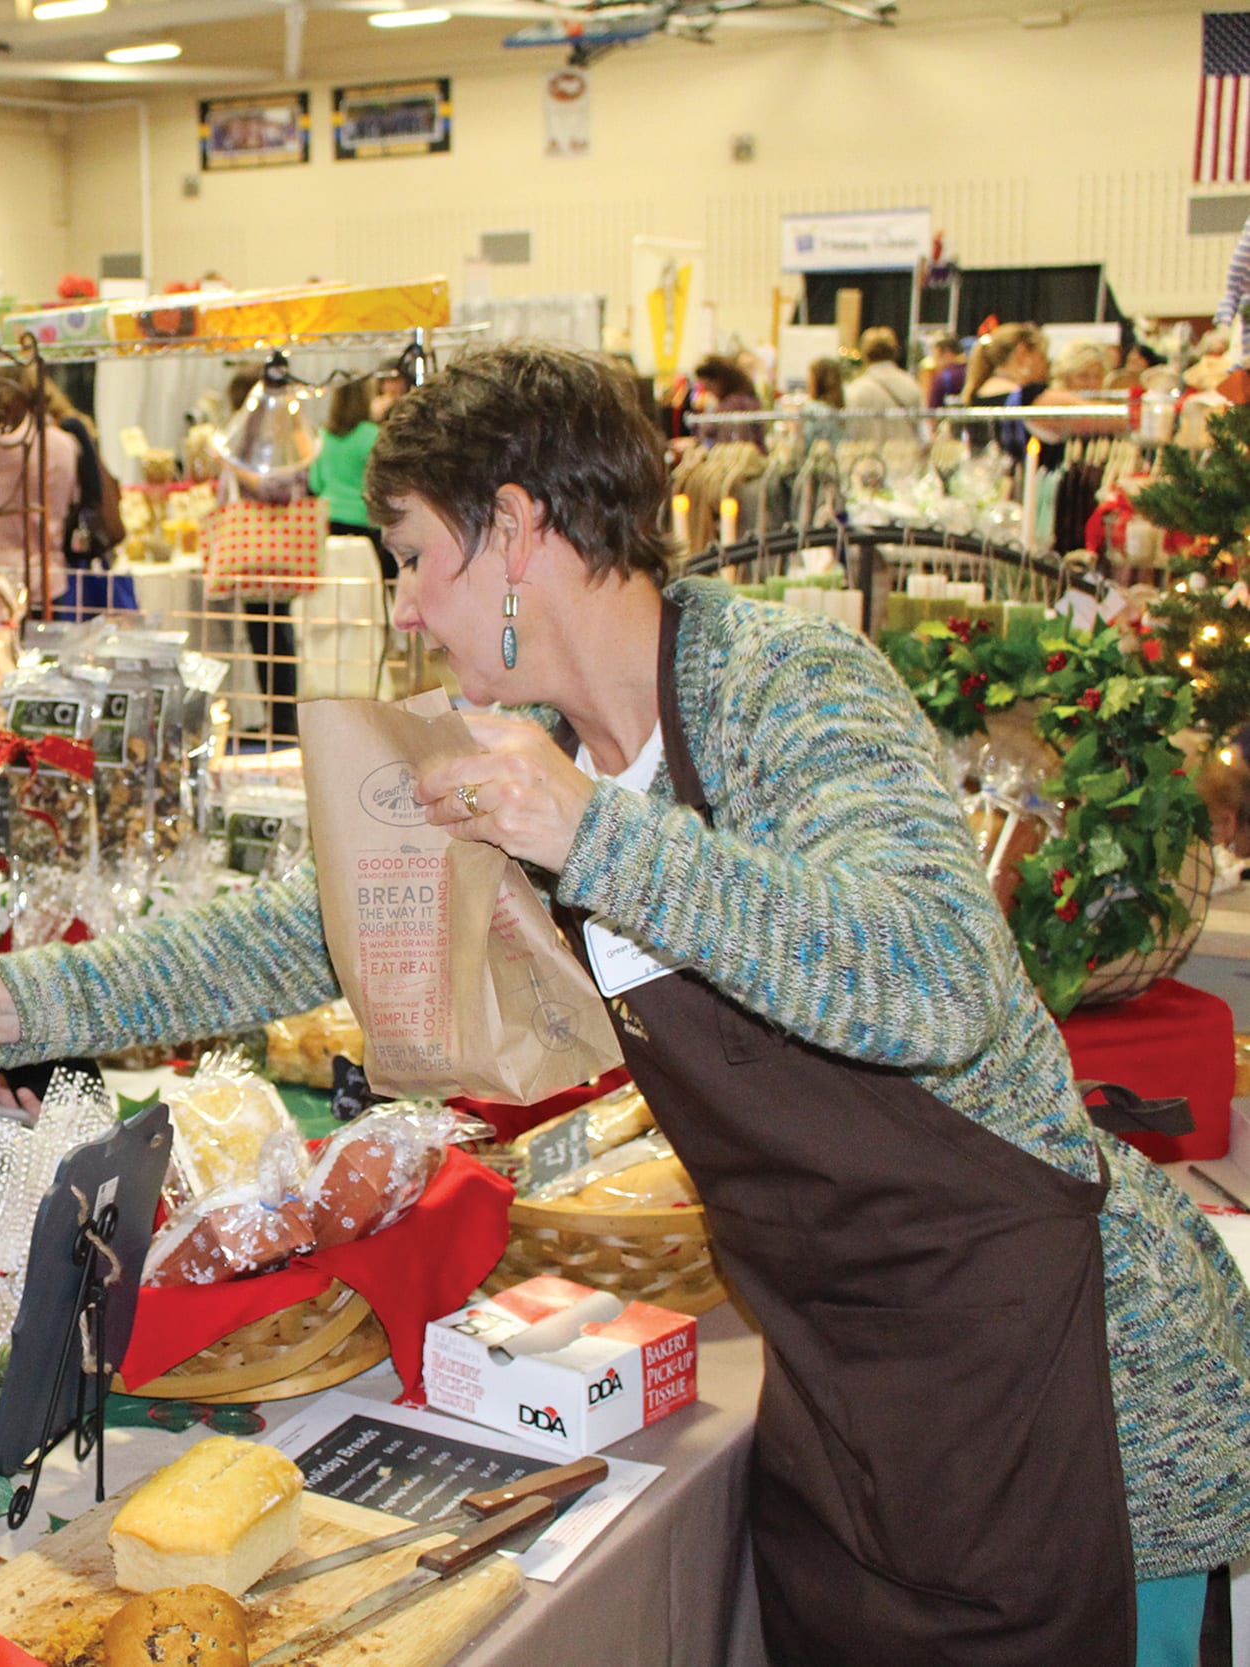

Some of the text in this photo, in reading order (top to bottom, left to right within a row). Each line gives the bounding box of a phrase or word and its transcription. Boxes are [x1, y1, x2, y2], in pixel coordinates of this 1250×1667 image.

[358, 857, 449, 870] GOOD FOOD
[358, 886, 434, 905] BREAD
[359, 906, 434, 920] THE WAY IT
[437, 880, 448, 946] BY HAND
[358, 921, 434, 933] OUGHT TO BE
[370, 940, 399, 949] WHOLE
[371, 961, 436, 975] EAT REAL
[373, 1012, 419, 1026] SIMPLE
[423, 986, 436, 1037] LOCAL
[409, 1043, 443, 1057] MADE
[646, 1330, 688, 1367] BAKERY
[647, 1351, 694, 1388] PICK-UP
[589, 1373, 623, 1405] DDA
[647, 1376, 686, 1409] TISSUE
[519, 1404, 567, 1438] DDA
[336, 1428, 381, 1458] Breads
